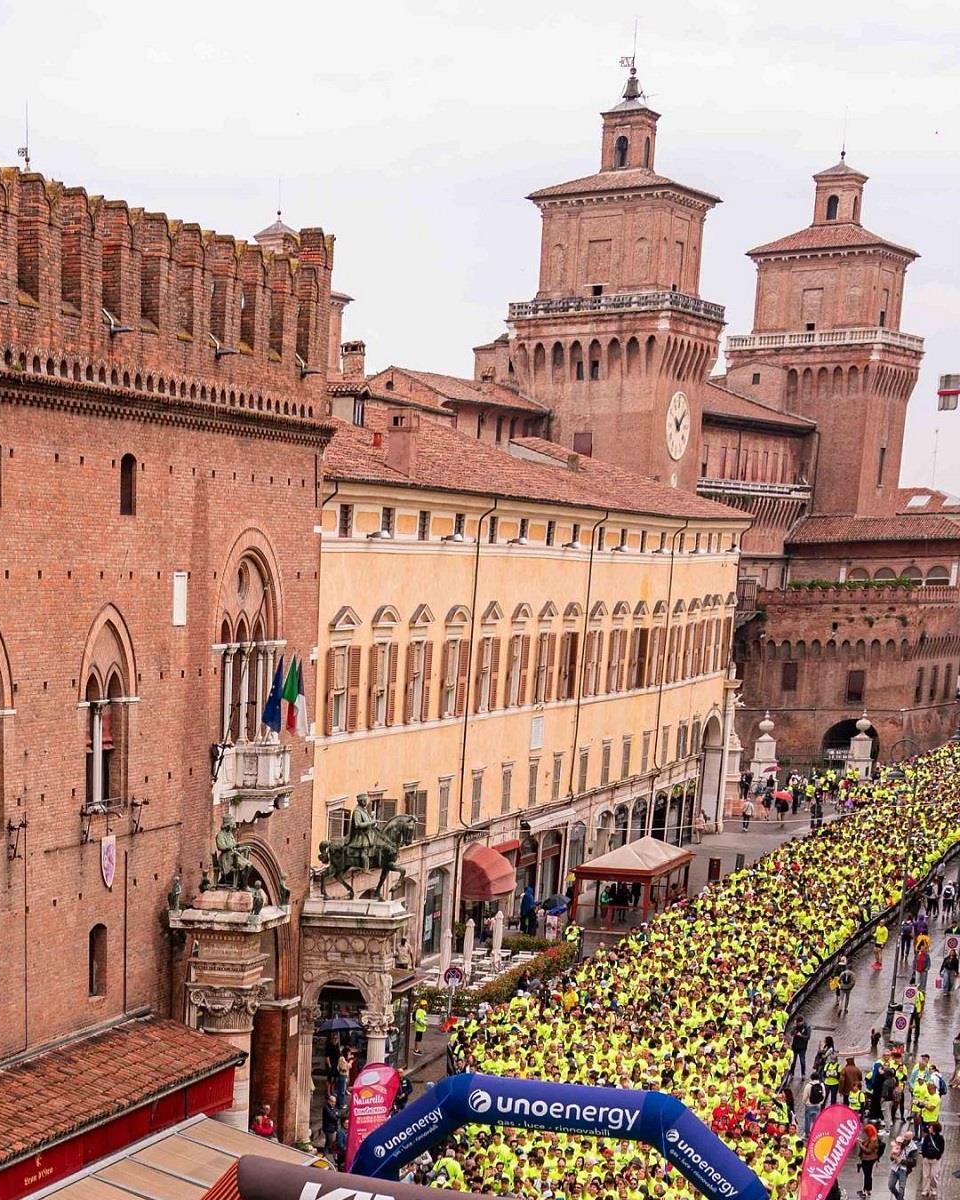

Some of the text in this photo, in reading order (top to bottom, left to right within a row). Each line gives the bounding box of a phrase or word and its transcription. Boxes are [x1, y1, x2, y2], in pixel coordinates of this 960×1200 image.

[384, 1107, 443, 1150] unoenergy
[497, 1096, 640, 1131] unoenergy
[497, 1119, 610, 1137] gas luce rinnovabili
[677, 1140, 739, 1198] unoenergy
[809, 1118, 858, 1186] Naturelle
